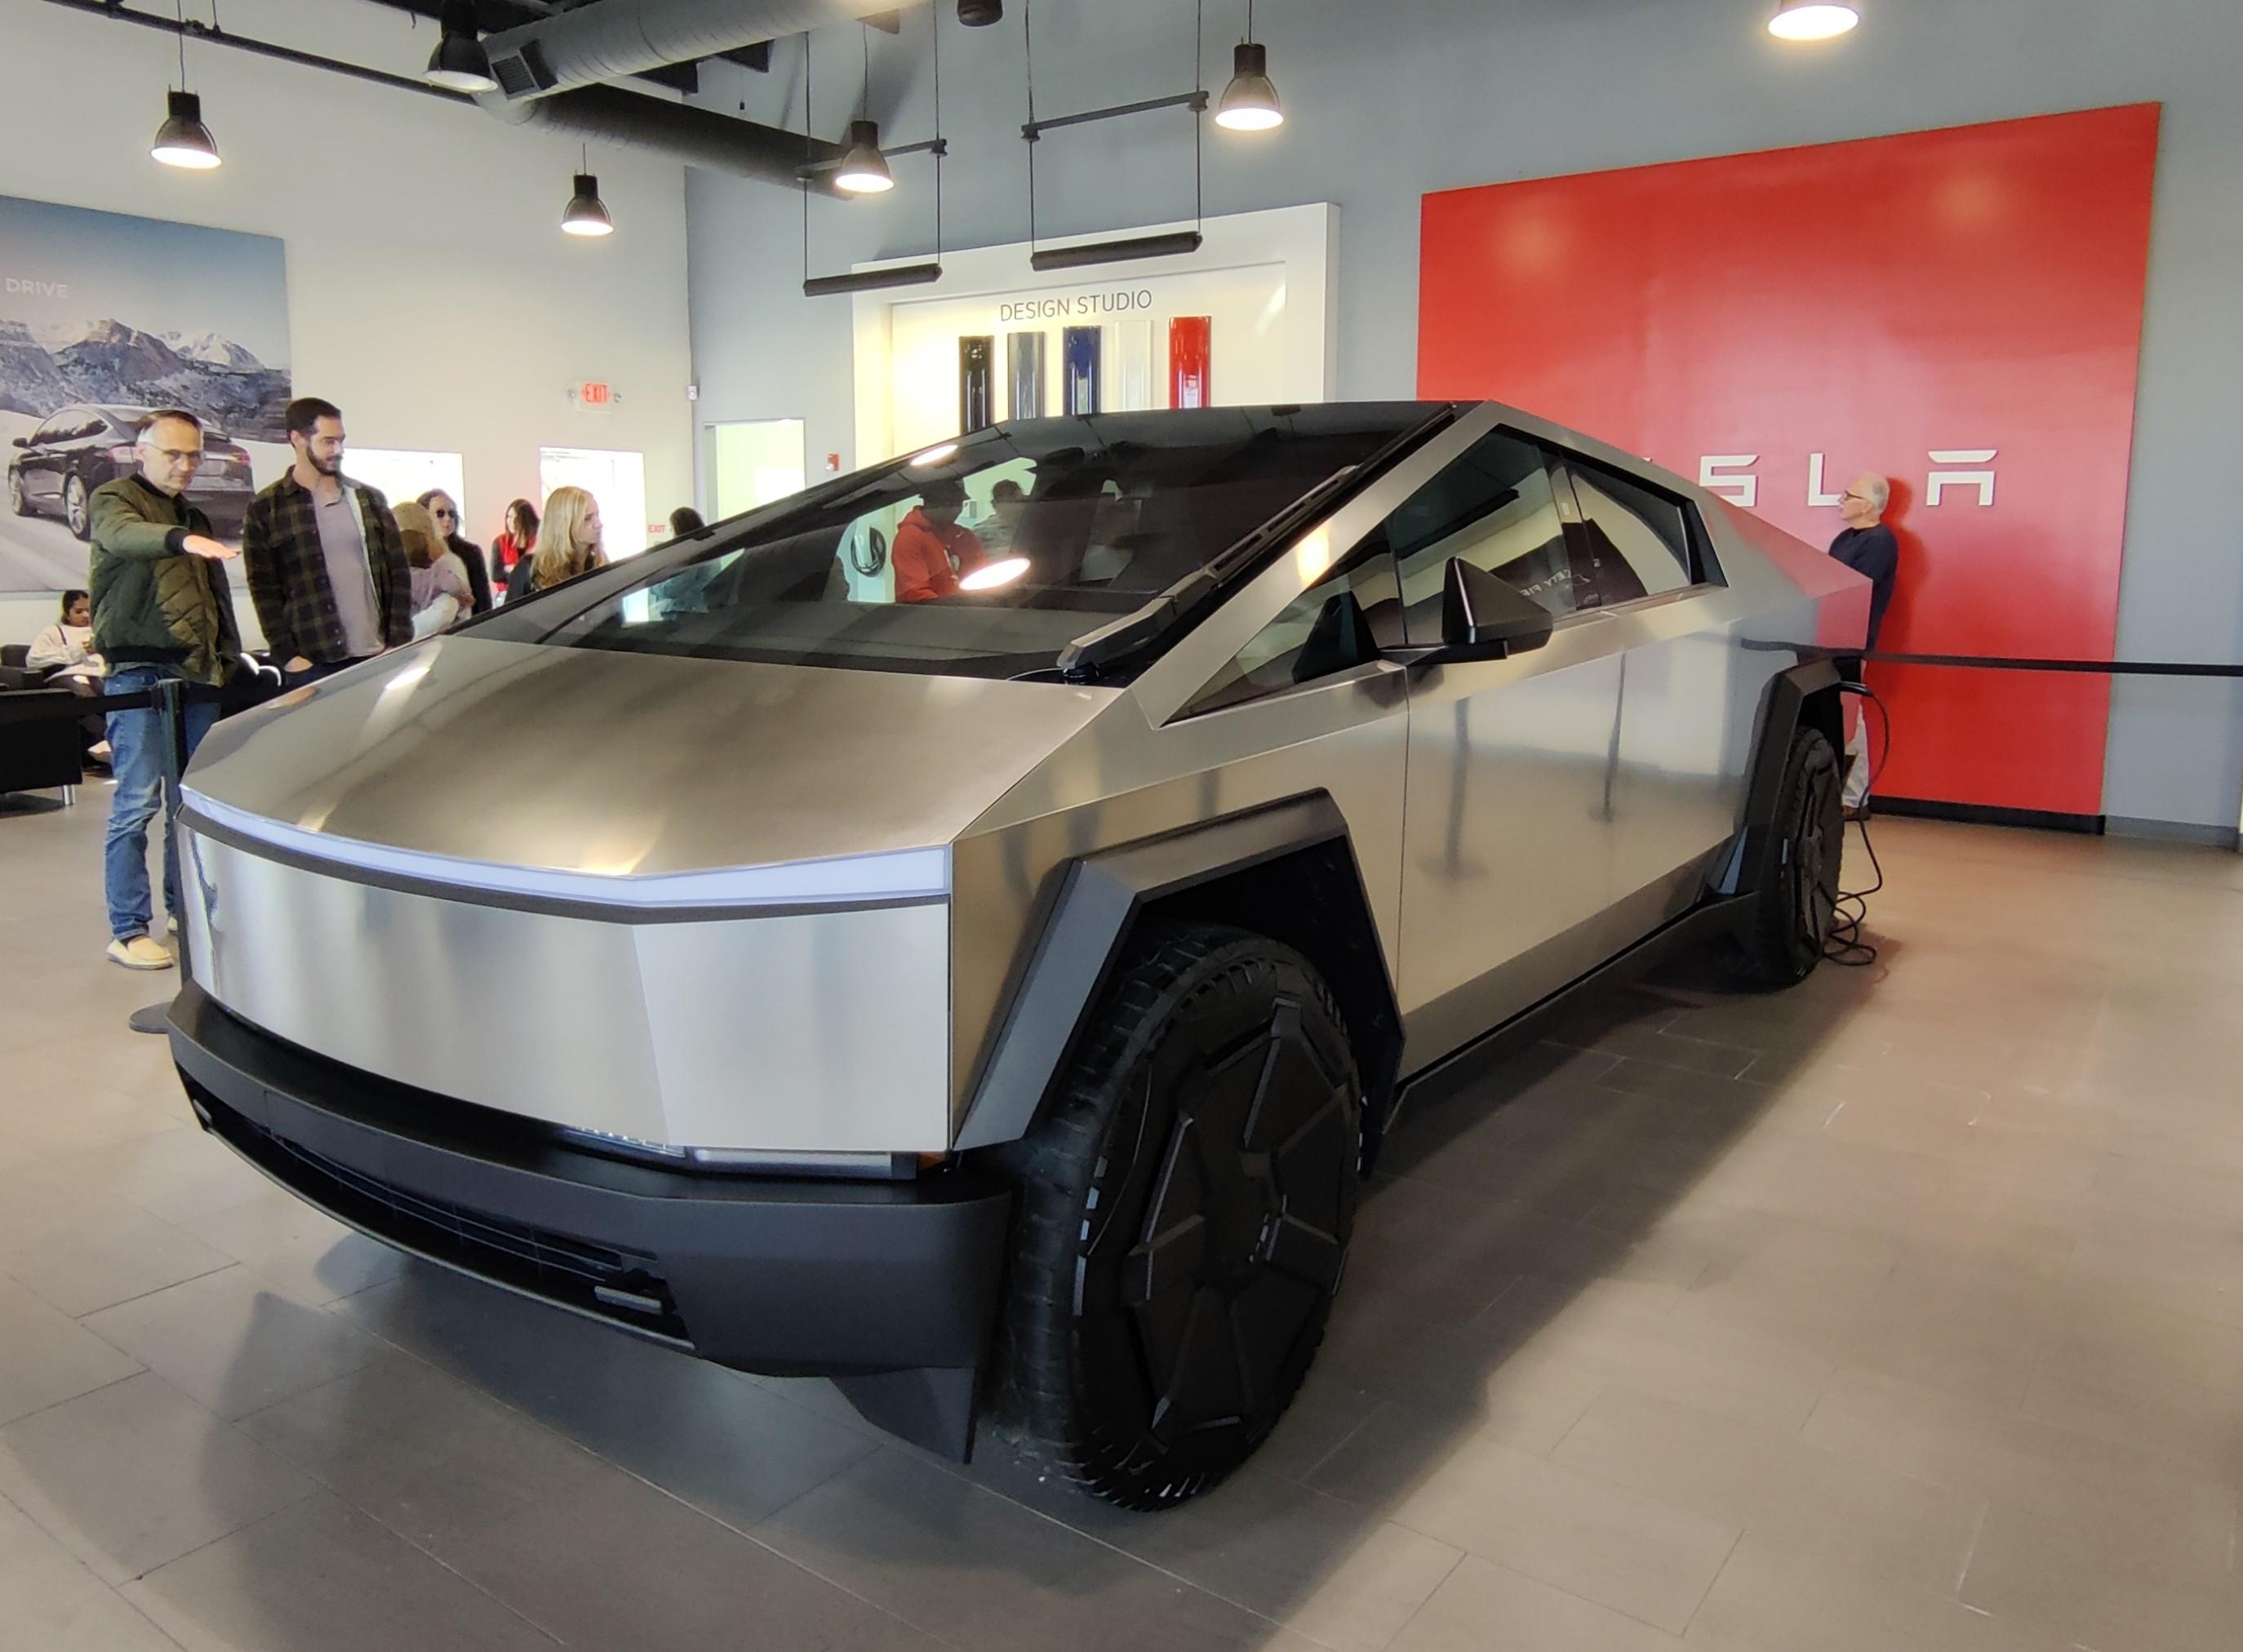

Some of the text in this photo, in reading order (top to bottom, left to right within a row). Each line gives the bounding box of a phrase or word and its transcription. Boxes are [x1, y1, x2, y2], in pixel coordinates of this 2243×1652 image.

[6, 278, 68, 299] DRIVE
[1001, 289, 1153, 322] DESIGN STUDIO
[585, 383, 607, 402] EXIT
[1645, 449, 1998, 508] SLA
[648, 523, 666, 534] EXIT
